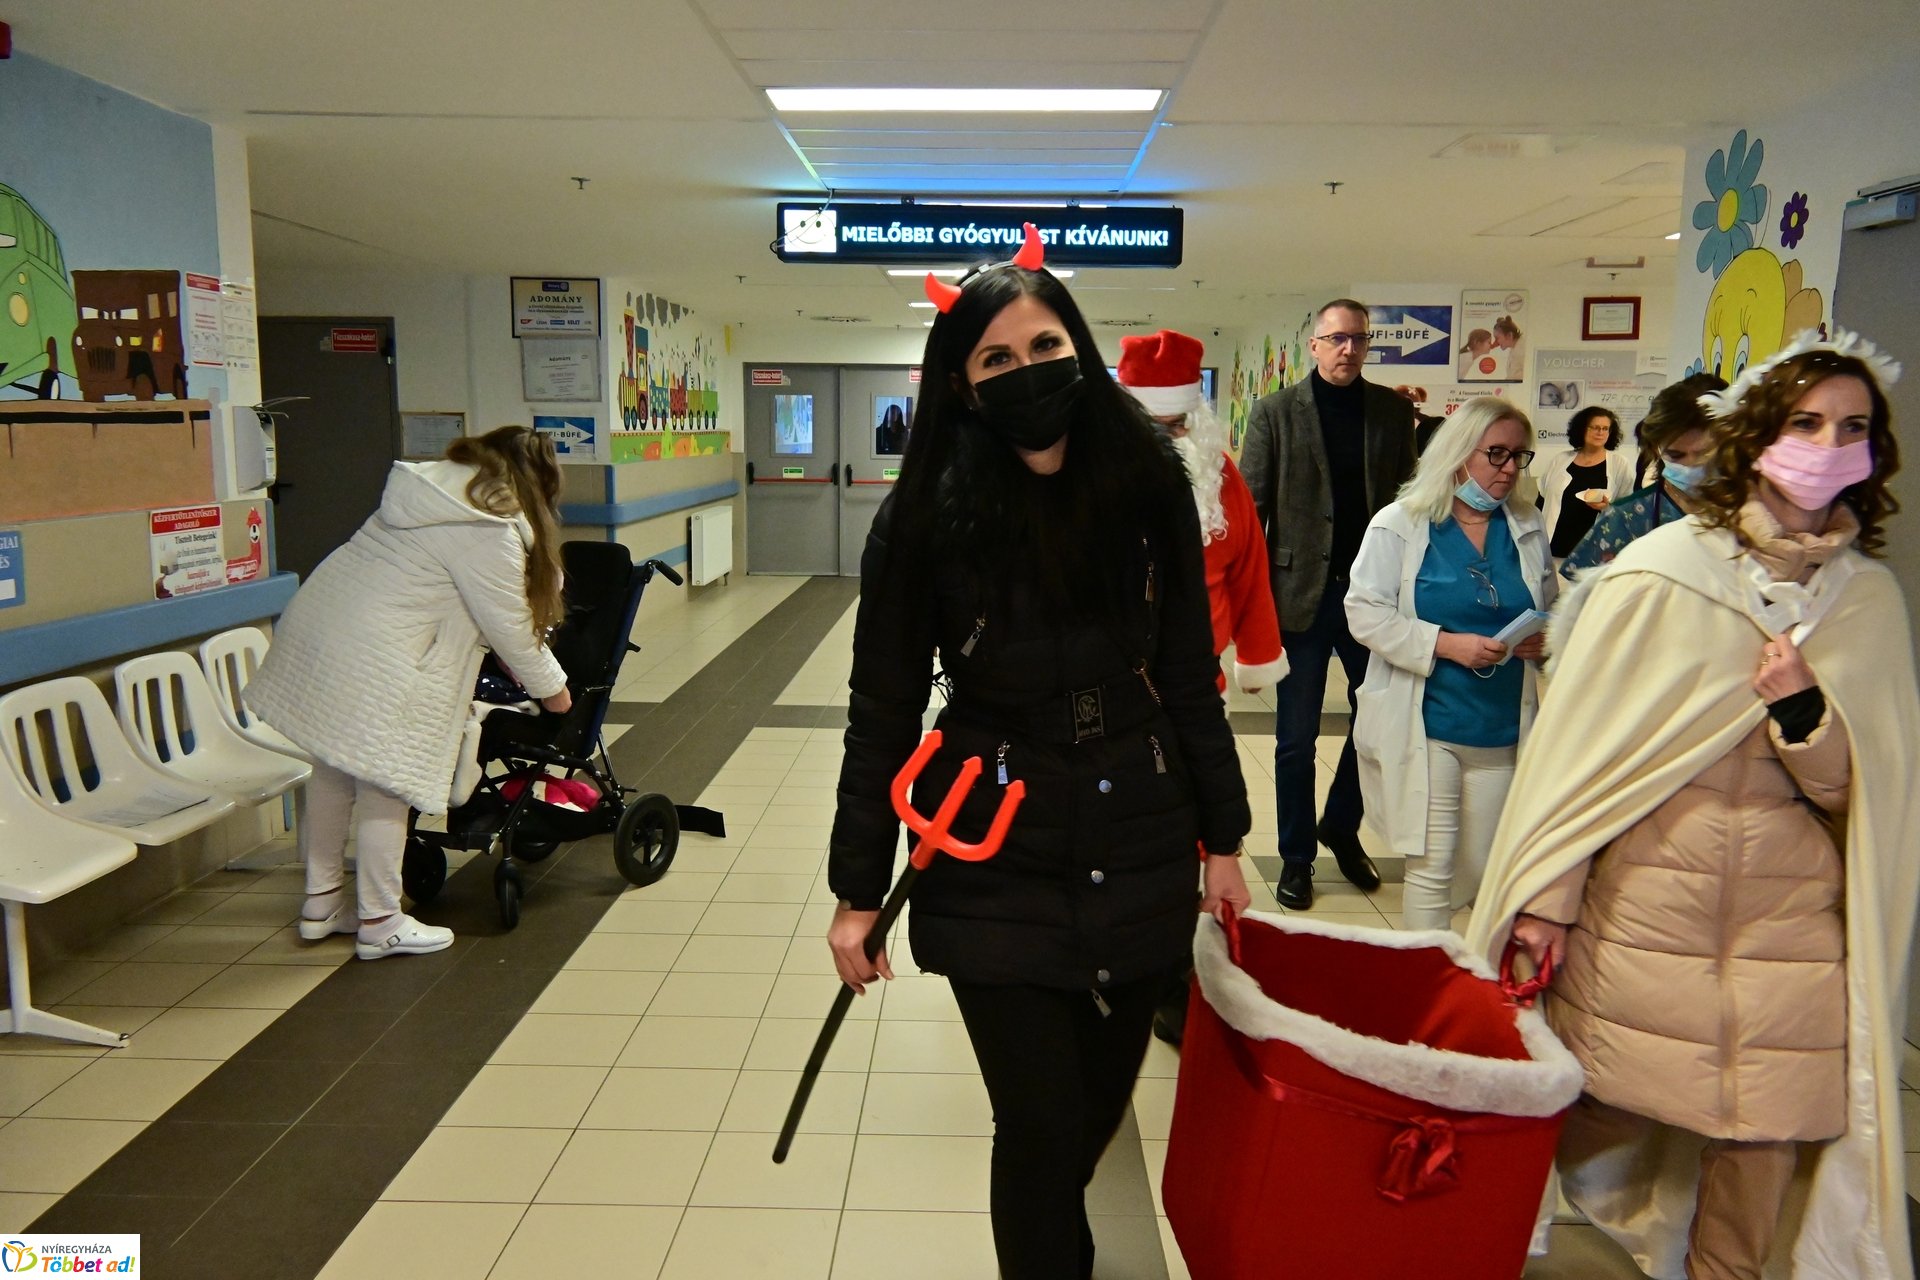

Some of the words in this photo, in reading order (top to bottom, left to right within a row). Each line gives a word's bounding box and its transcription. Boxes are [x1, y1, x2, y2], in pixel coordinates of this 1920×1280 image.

[841, 221, 934, 243] MIELŐBBI
[938, 222, 1060, 245] GYÓGYULST
[1065, 224, 1169, 247] KÍVÁNUNK!
[530, 294, 582, 303] ADOMÁNY
[1543, 358, 1606, 369] VOUCHER
